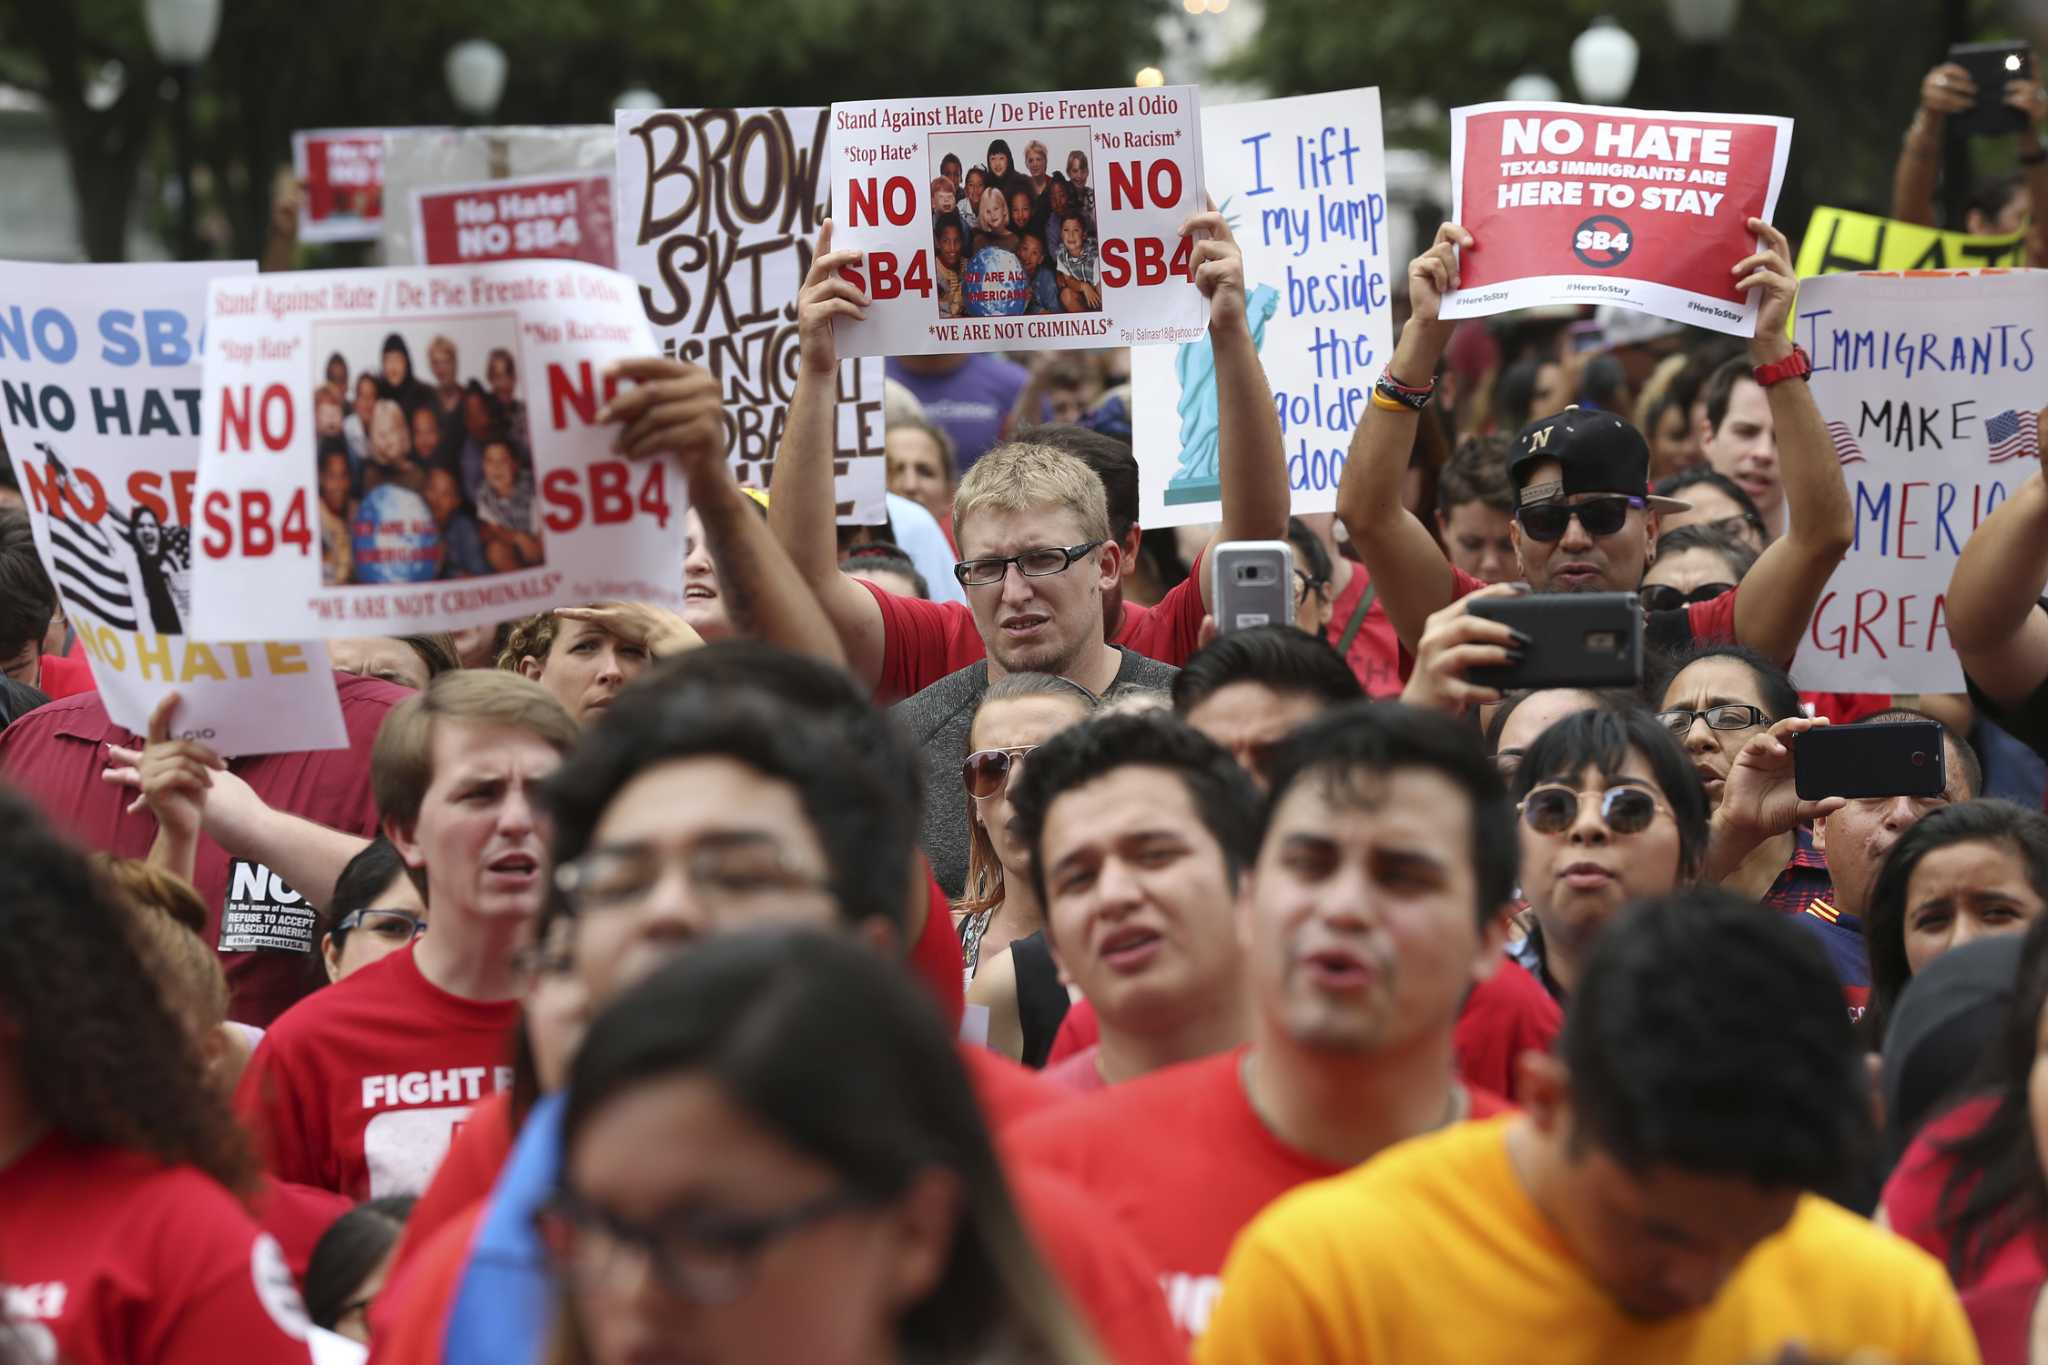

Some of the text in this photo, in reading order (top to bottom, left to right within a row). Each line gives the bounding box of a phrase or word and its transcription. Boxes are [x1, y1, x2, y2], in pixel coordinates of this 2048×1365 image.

[836, 94, 1178, 133] Stand Against Hate / De Pie Frente al Odio
[1241, 126, 1361, 197] I lift
[1501, 118, 1732, 166] NO HATE
[1108, 158, 1183, 211] NO
[1497, 181, 1724, 217] HERE TO STAY
[1500, 160, 1727, 187] TEXAS IMMIGRANTS ARE
[455, 198, 496, 226] No
[848, 174, 917, 228] NO
[1262, 192, 1384, 257] my lamp
[457, 225, 511, 257] NO
[1100, 235, 1196, 289] SB4
[1575, 229, 1630, 252] SB4
[838, 249, 933, 300] SB4
[984, 271, 1005, 283] ARE
[1287, 259, 1387, 318] beside
[1566, 282, 1631, 297] #HereToStay
[0, 305, 206, 367] NO SB
[962, 324, 991, 341] ARE
[995, 322, 1024, 340] NOT
[1686, 301, 1744, 324] #HereToStay
[1308, 326, 1374, 380] the
[1800, 309, 2034, 379] IMMIGRANTS
[2, 380, 201, 437] NO HAT
[219, 382, 295, 453] NO
[1858, 399, 1977, 452] MAKE
[1288, 438, 1346, 491] doo
[1528, 425, 1555, 453] N
[201, 487, 313, 560] SB4
[541, 461, 671, 533] SB4
[72, 613, 309, 683] NO HATE
[1812, 588, 1956, 660] GREA
[226, 923, 312, 939] A FASCIST AMERICA
[228, 912, 315, 929] REFUSE TO ACCEPT
[362, 1066, 486, 1109] FIGHT
